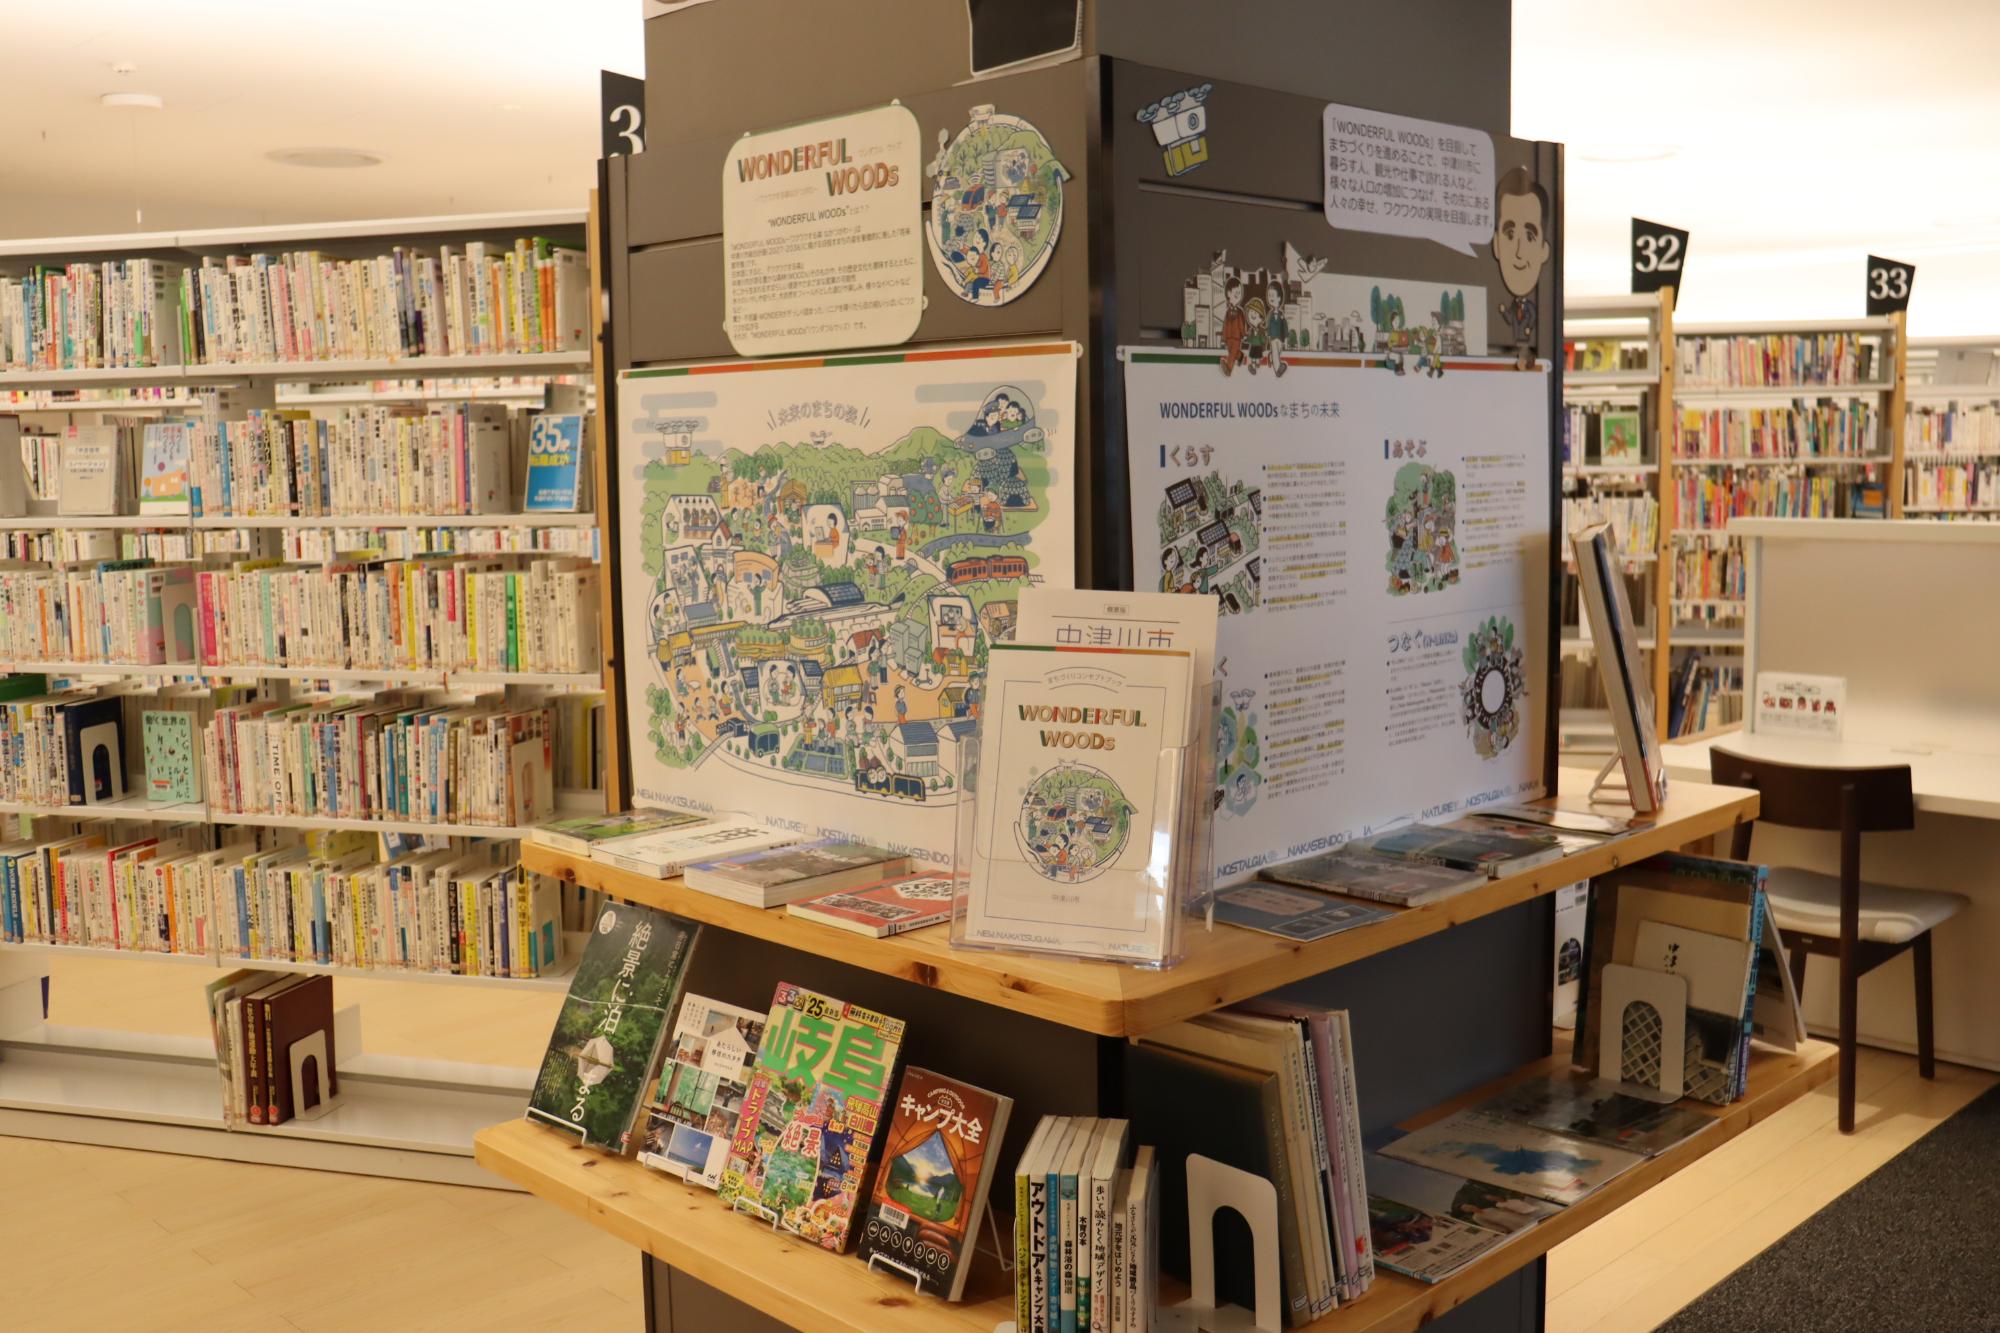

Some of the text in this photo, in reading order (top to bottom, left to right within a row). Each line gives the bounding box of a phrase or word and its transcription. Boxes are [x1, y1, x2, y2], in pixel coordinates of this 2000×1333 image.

[737, 138, 852, 183] WONDERFUL
[826, 162, 899, 196] WOODs
[1635, 234, 1681, 273] 32
[1870, 267, 1908, 299] 33
[1160, 402, 1235, 419] WONDERFUL
[1169, 444, 1215, 467] くらす
[1056, 624, 1174, 648] 中津川市
[1018, 704, 1147, 727] WONDERFUL
[1040, 730, 1115, 751] WOODs
[272, 744, 280, 775] TIME
[1217, 833, 1344, 878] NOSTALGIA NAKASENDO
[570, 920, 652, 1122] 絶景に泊まる
[763, 1008, 886, 1101] 岐阜
[900, 1094, 983, 1145] キャンプ大全
[731, 1139, 755, 1154] MAP
[782, 1121, 820, 1157] 絶景
